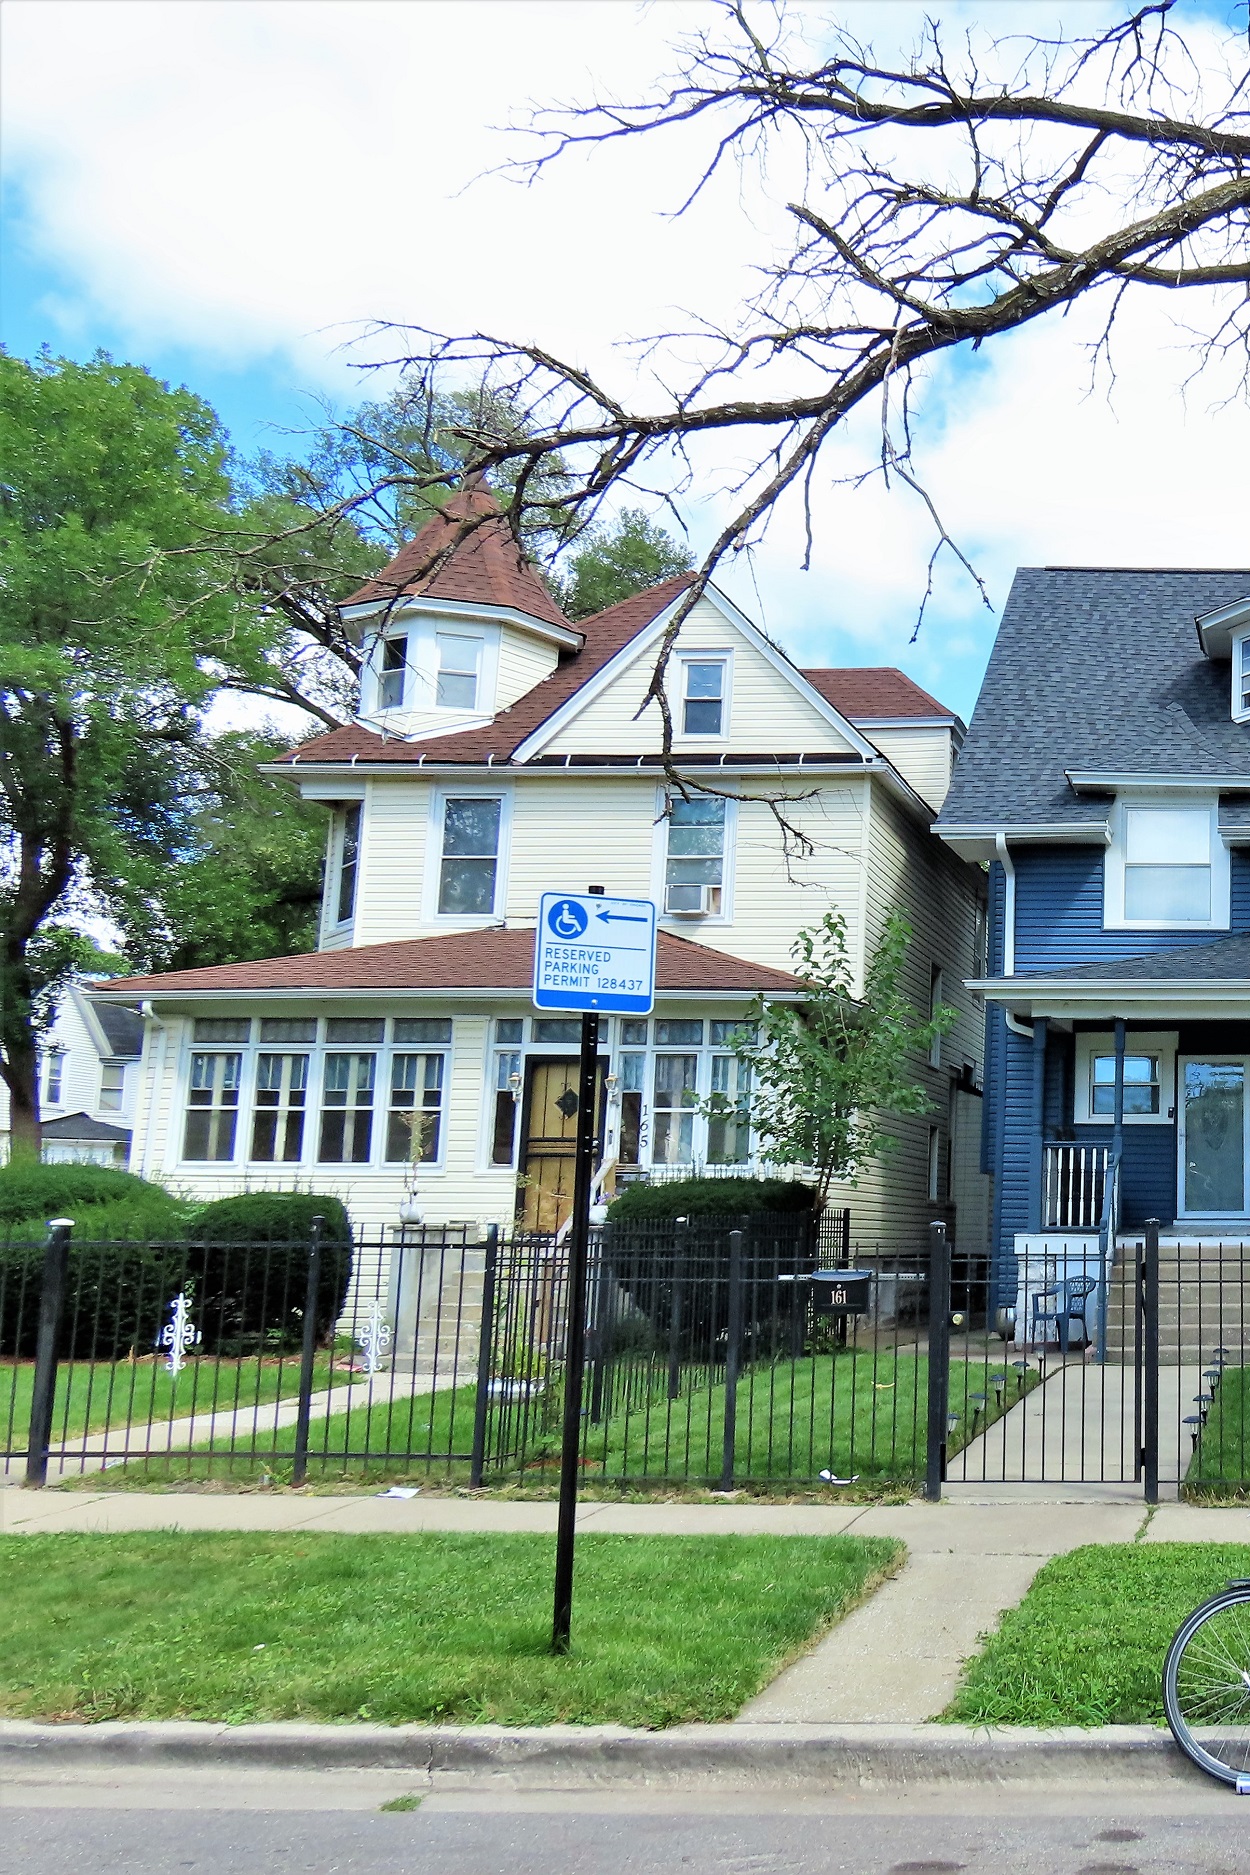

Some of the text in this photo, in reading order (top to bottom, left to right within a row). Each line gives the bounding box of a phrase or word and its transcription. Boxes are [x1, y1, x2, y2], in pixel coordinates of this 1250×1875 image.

[545, 947, 611, 962] RESERVED
[545, 960, 599, 975] PARKING
[544, 974, 643, 991] PERMIT 128437
[640, 1104, 649, 1148] 165
[831, 1290, 847, 1305] 161
